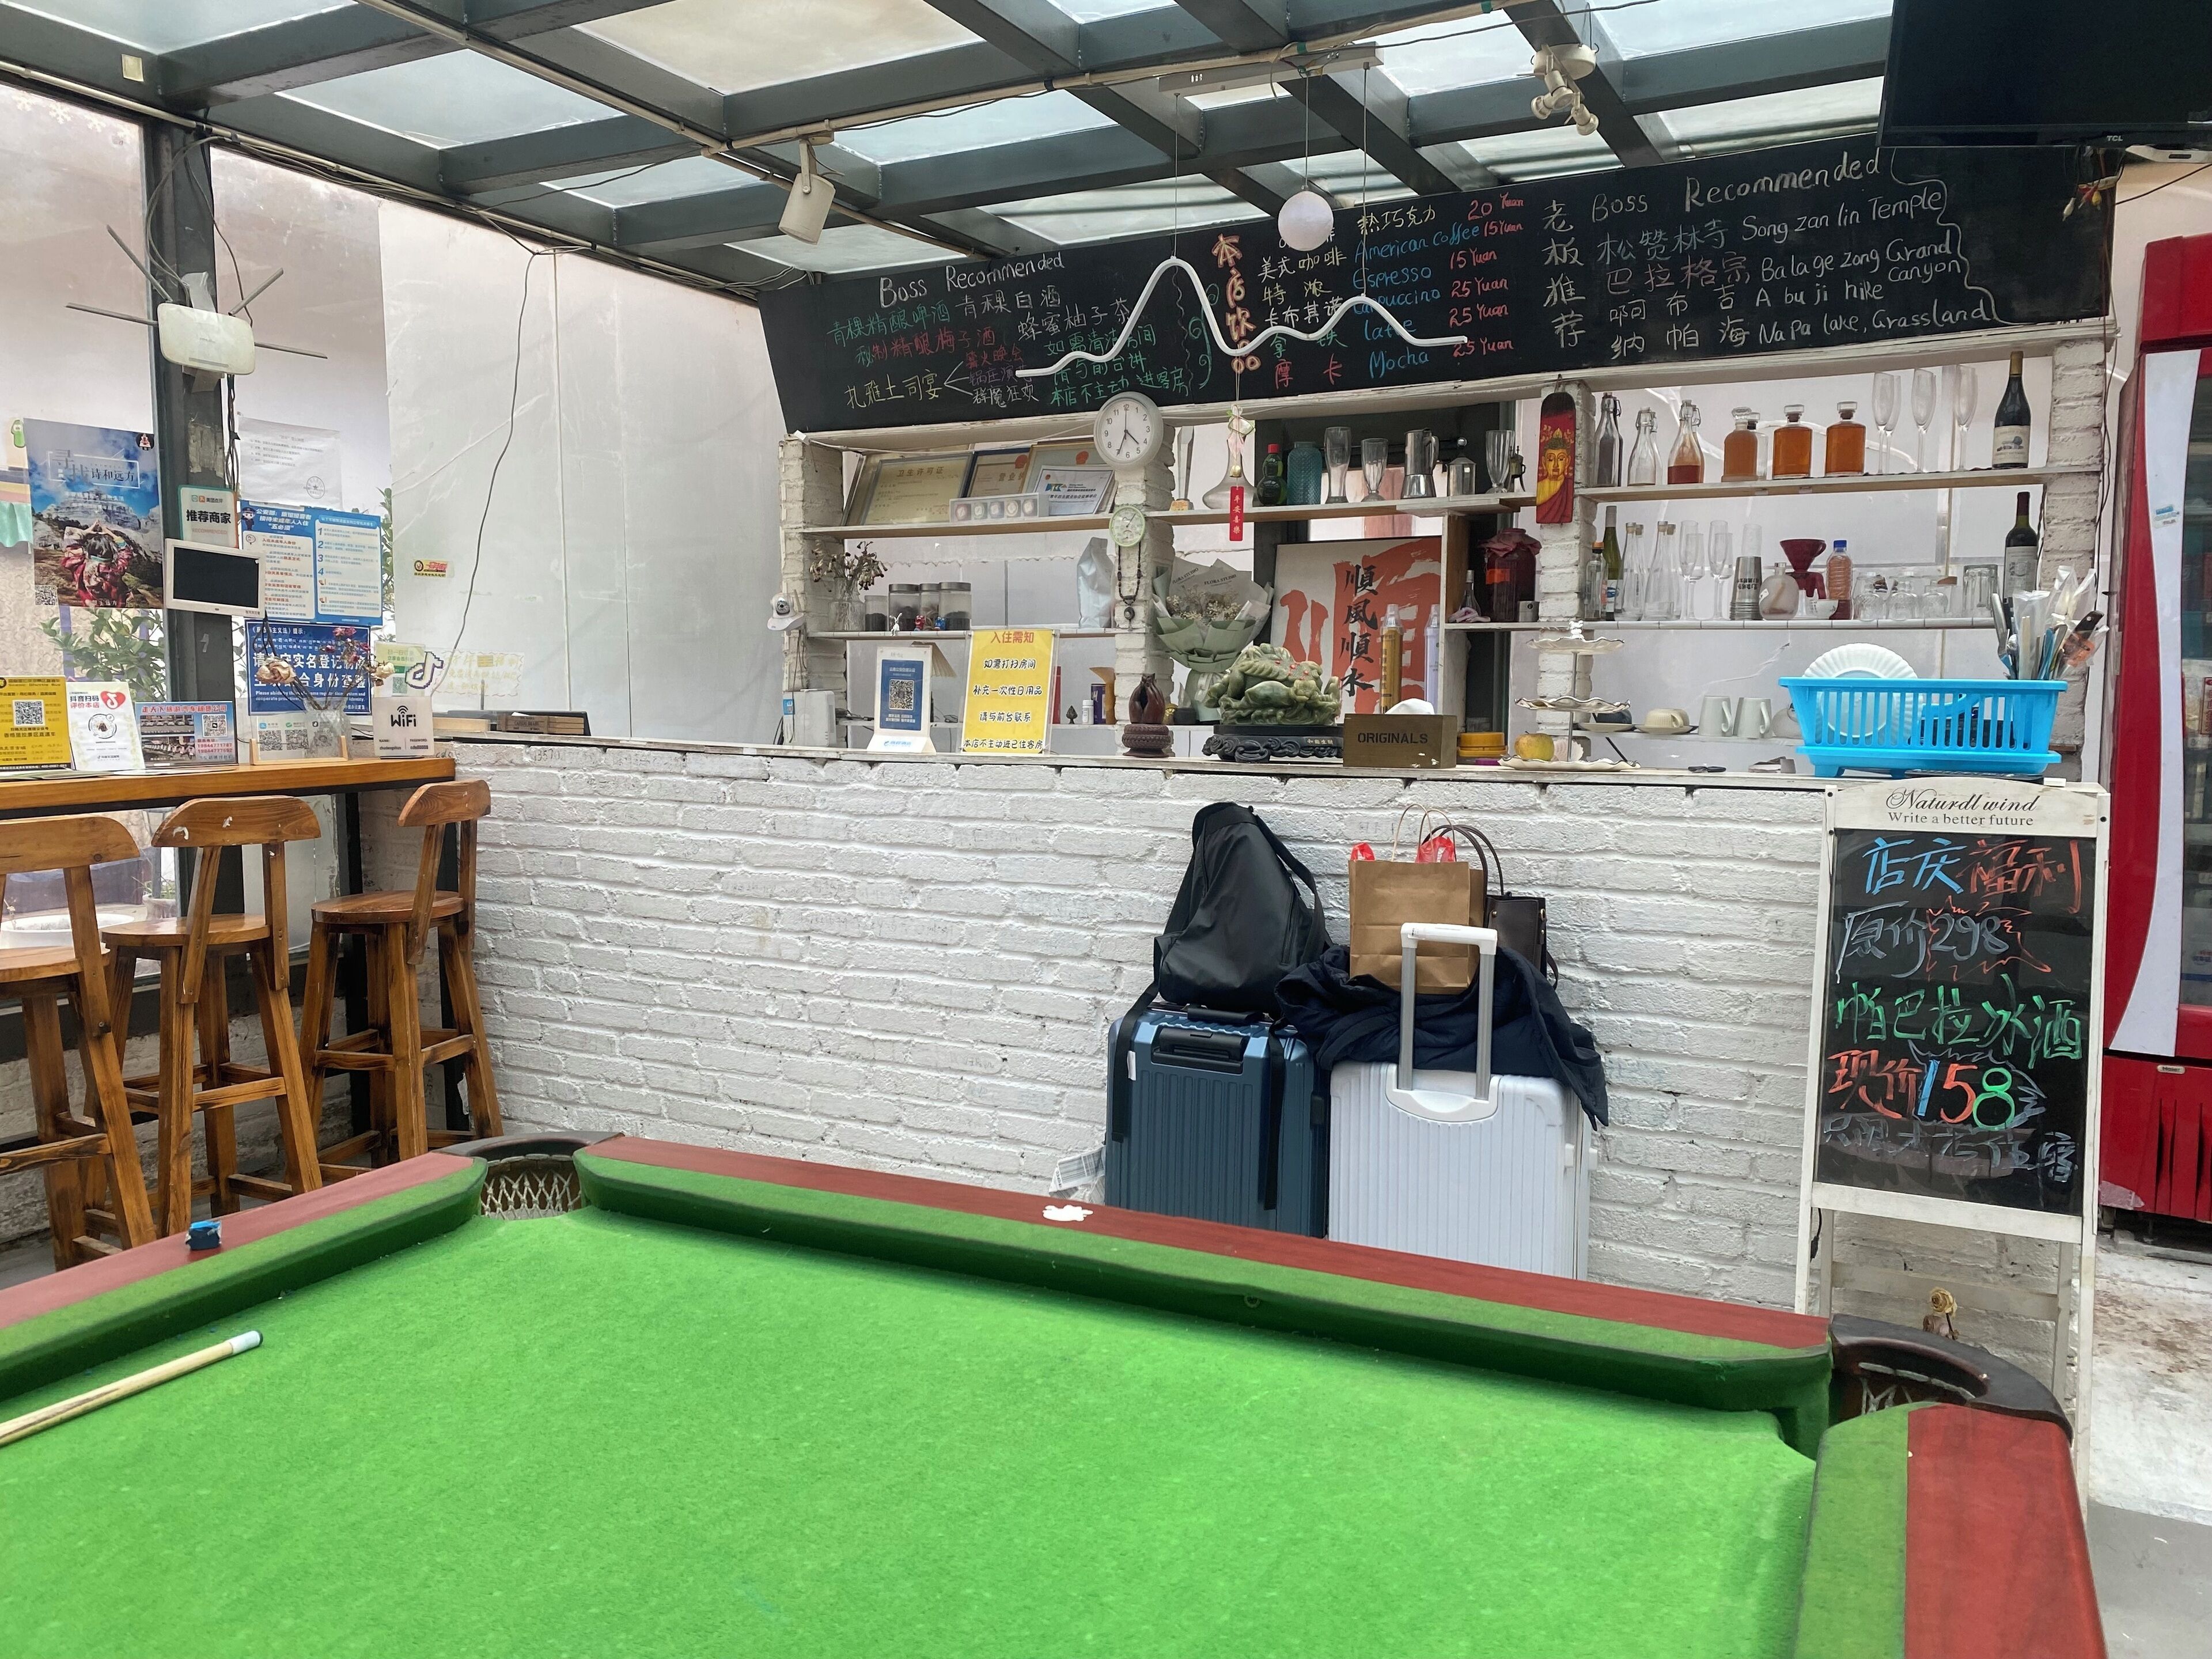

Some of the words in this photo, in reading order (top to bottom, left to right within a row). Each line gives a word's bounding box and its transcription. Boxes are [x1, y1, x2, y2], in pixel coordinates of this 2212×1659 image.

[1592, 194, 1648, 223] Boss
[1685, 147, 1880, 212] Recommended
[1468, 200, 1493, 221] 20
[1742, 215, 1788, 244] Song
[1869, 186, 1942, 219] Temple
[1484, 221, 1497, 237] 15
[1597, 218, 1728, 265] 松赞林寺
[1887, 229, 1952, 260] Grand
[1355, 240, 1429, 263] American
[1450, 250, 1467, 270] 15
[1469, 248, 1497, 266] Yuan
[1257, 245, 1347, 283] 美式咖啡
[880, 277, 927, 308] Boss
[946, 252, 1065, 291] Recommended
[1353, 267, 1431, 289] Espresso
[1542, 200, 1586, 348] 老板推荐
[1262, 278, 1332, 306] 特浓
[1451, 280, 1472, 298] 25
[1475, 277, 1509, 296] Yuan
[1018, 297, 1130, 342] 蜂蜜柚子茶
[1449, 306, 1472, 328] 25
[1476, 304, 1509, 320] Yuan
[1872, 298, 1991, 329] Grassland
[1480, 338, 1514, 355] Yuan
[1275, 353, 1343, 389] 摩卡
[1370, 347, 1429, 378] Mocha
[92, 468, 135, 482] 诗和远方
[896, 465, 945, 478] 卫生许可证
[186, 509, 232, 524] 推荐商家
[318, 527, 323, 536] 1
[318, 540, 324, 548] 2
[318, 554, 324, 562] 3
[318, 567, 324, 575] 4
[1220, 574, 1236, 582] STUDIO
[991, 631, 1035, 644] 入住需知
[983, 658, 1036, 670] 如需打扫房间
[973, 685, 1043, 696] 补充一次性日用品
[142, 704, 227, 713] 走天下旅游汽车租赁公司
[980, 711, 1031, 722] 请与前台联系
[391, 714, 416, 727] WiFi
[963, 739, 1044, 750] 本店不主动进已住客房
[1358, 733, 1428, 745] ORIGINALS
[1983, 795, 2041, 812] wind
[1888, 812, 1927, 824] Write
[1931, 816, 1940, 824] a
[1944, 813, 1986, 825] better
[1988, 813, 2035, 826] future
